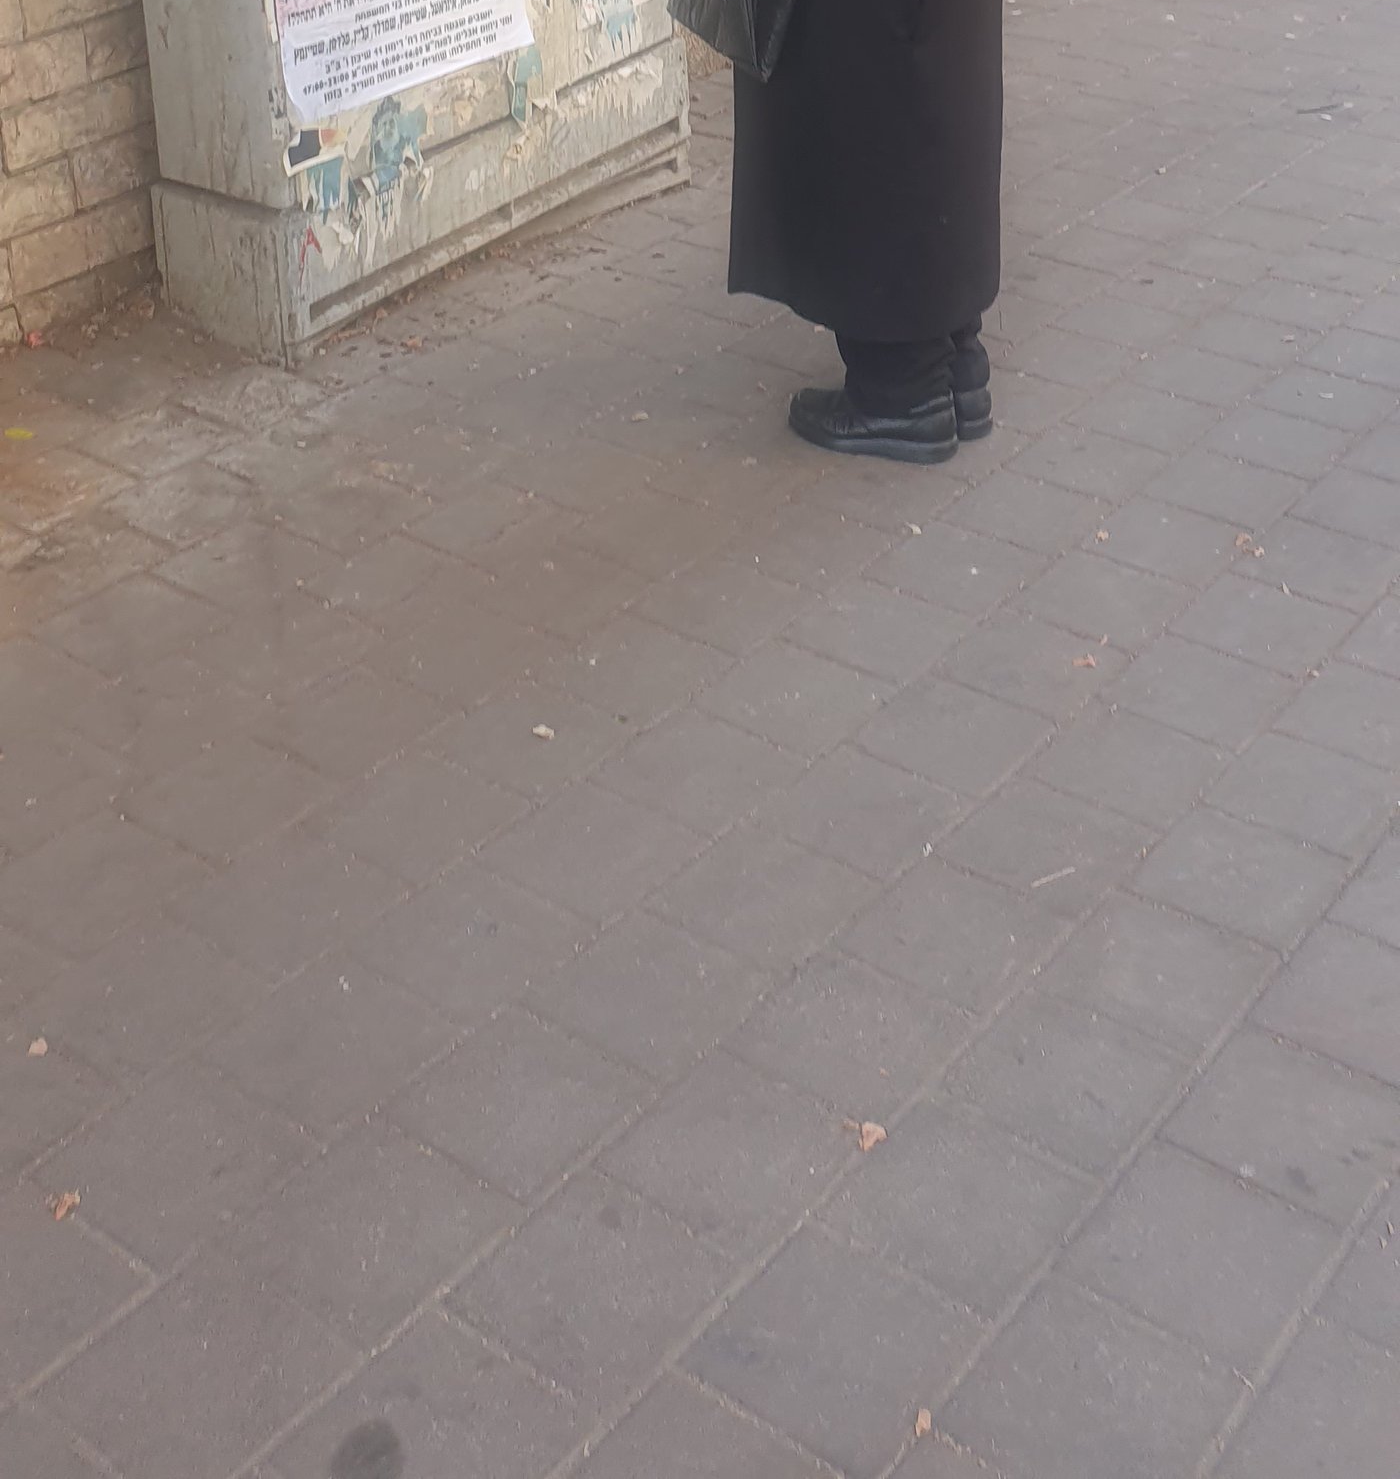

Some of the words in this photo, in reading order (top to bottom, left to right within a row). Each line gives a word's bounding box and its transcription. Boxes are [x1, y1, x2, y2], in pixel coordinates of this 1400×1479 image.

[468, 9, 492, 24] יושבים
[499, 14, 512, 26] זמני
[444, 18, 466, 33] שבעה
[483, 33, 496, 44] זמני
[324, 88, 342, 104] בזמן
